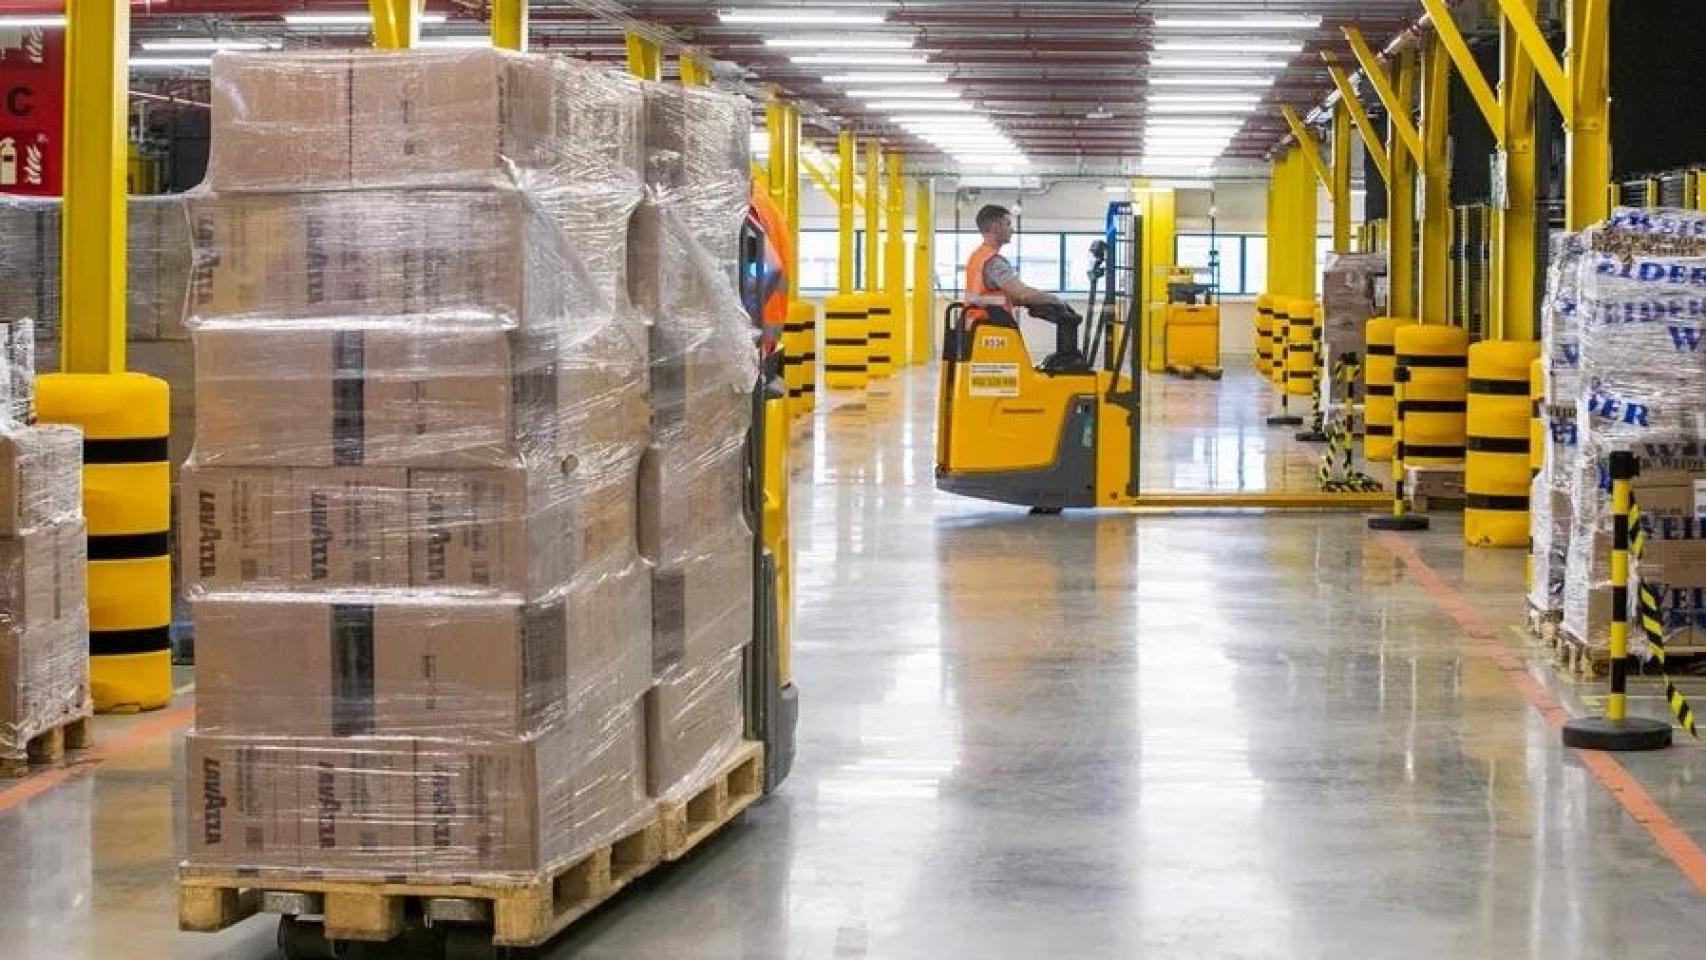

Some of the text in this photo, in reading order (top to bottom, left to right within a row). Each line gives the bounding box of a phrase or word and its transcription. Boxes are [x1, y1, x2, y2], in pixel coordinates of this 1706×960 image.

[199, 489, 222, 578] LAVAZZA
[311, 492, 333, 581] LAVAZZA
[204, 757, 227, 845] LAVAZZA
[318, 761, 341, 849] LAVAZZA
